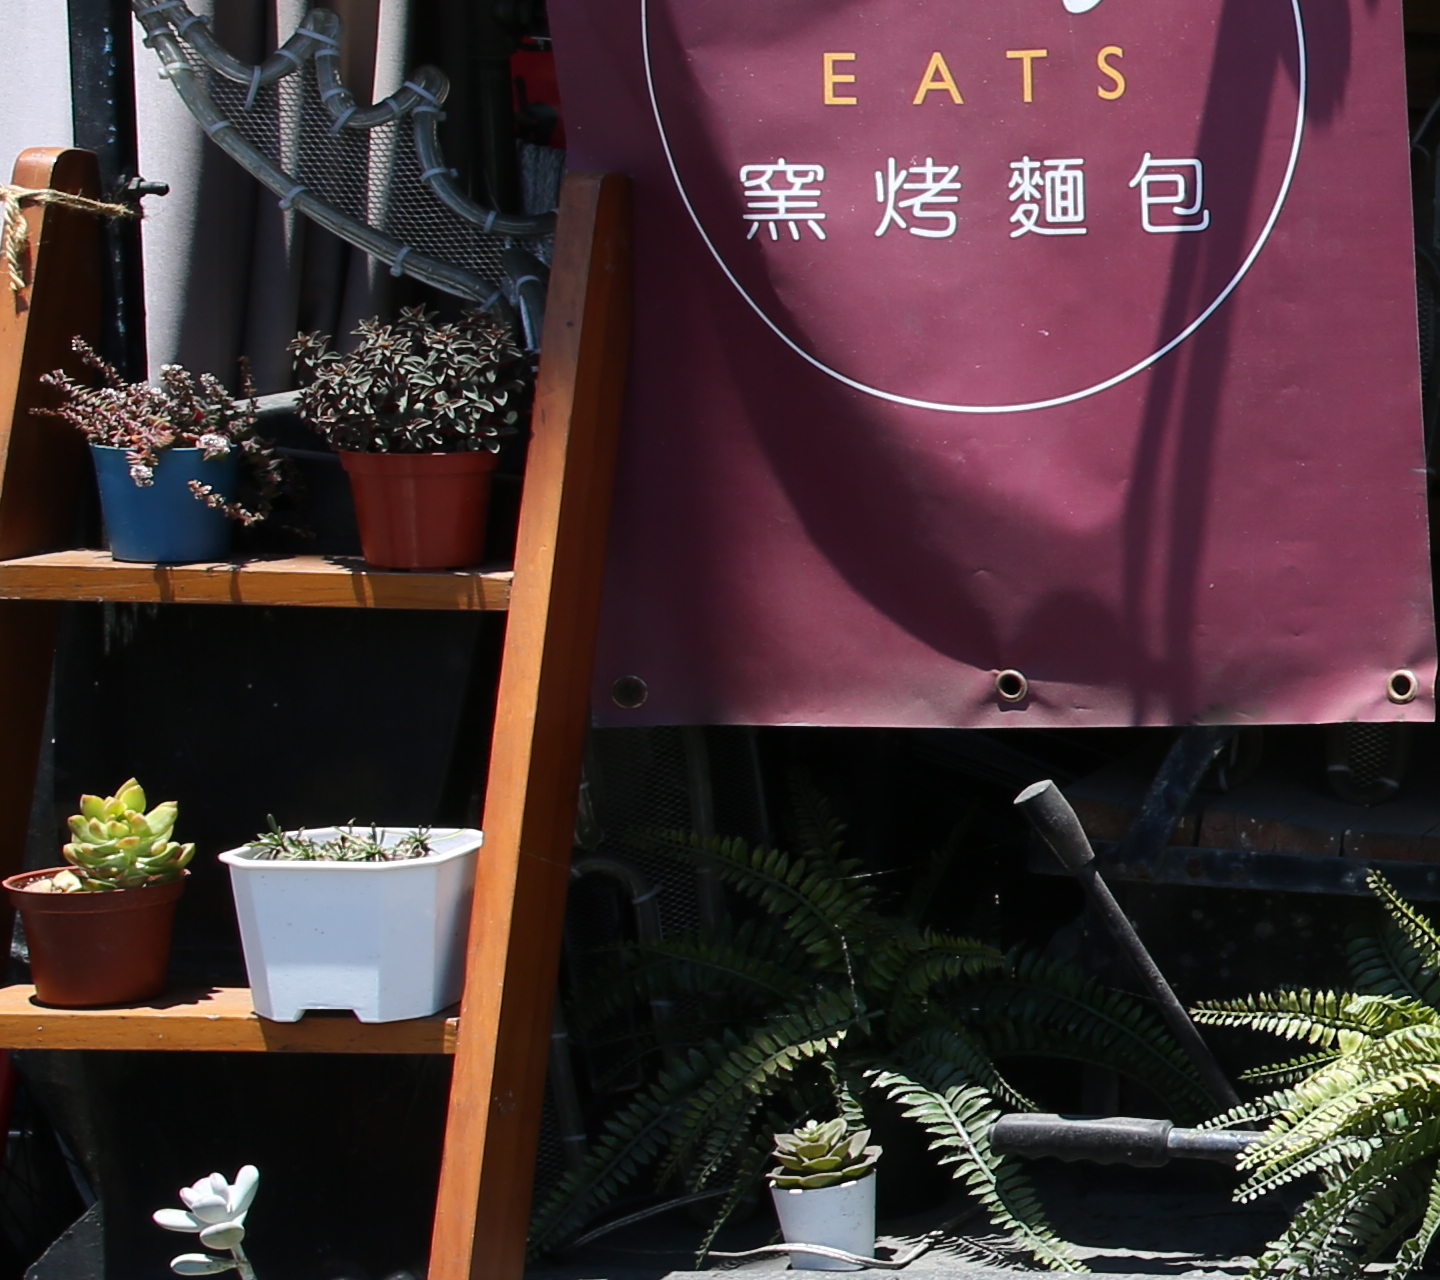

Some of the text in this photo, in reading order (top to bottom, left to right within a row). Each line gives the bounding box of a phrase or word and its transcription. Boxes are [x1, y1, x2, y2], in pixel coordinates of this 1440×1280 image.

[822, 46, 1127, 106] EATS
[739, 153, 1210, 241] 窯烤麵包
